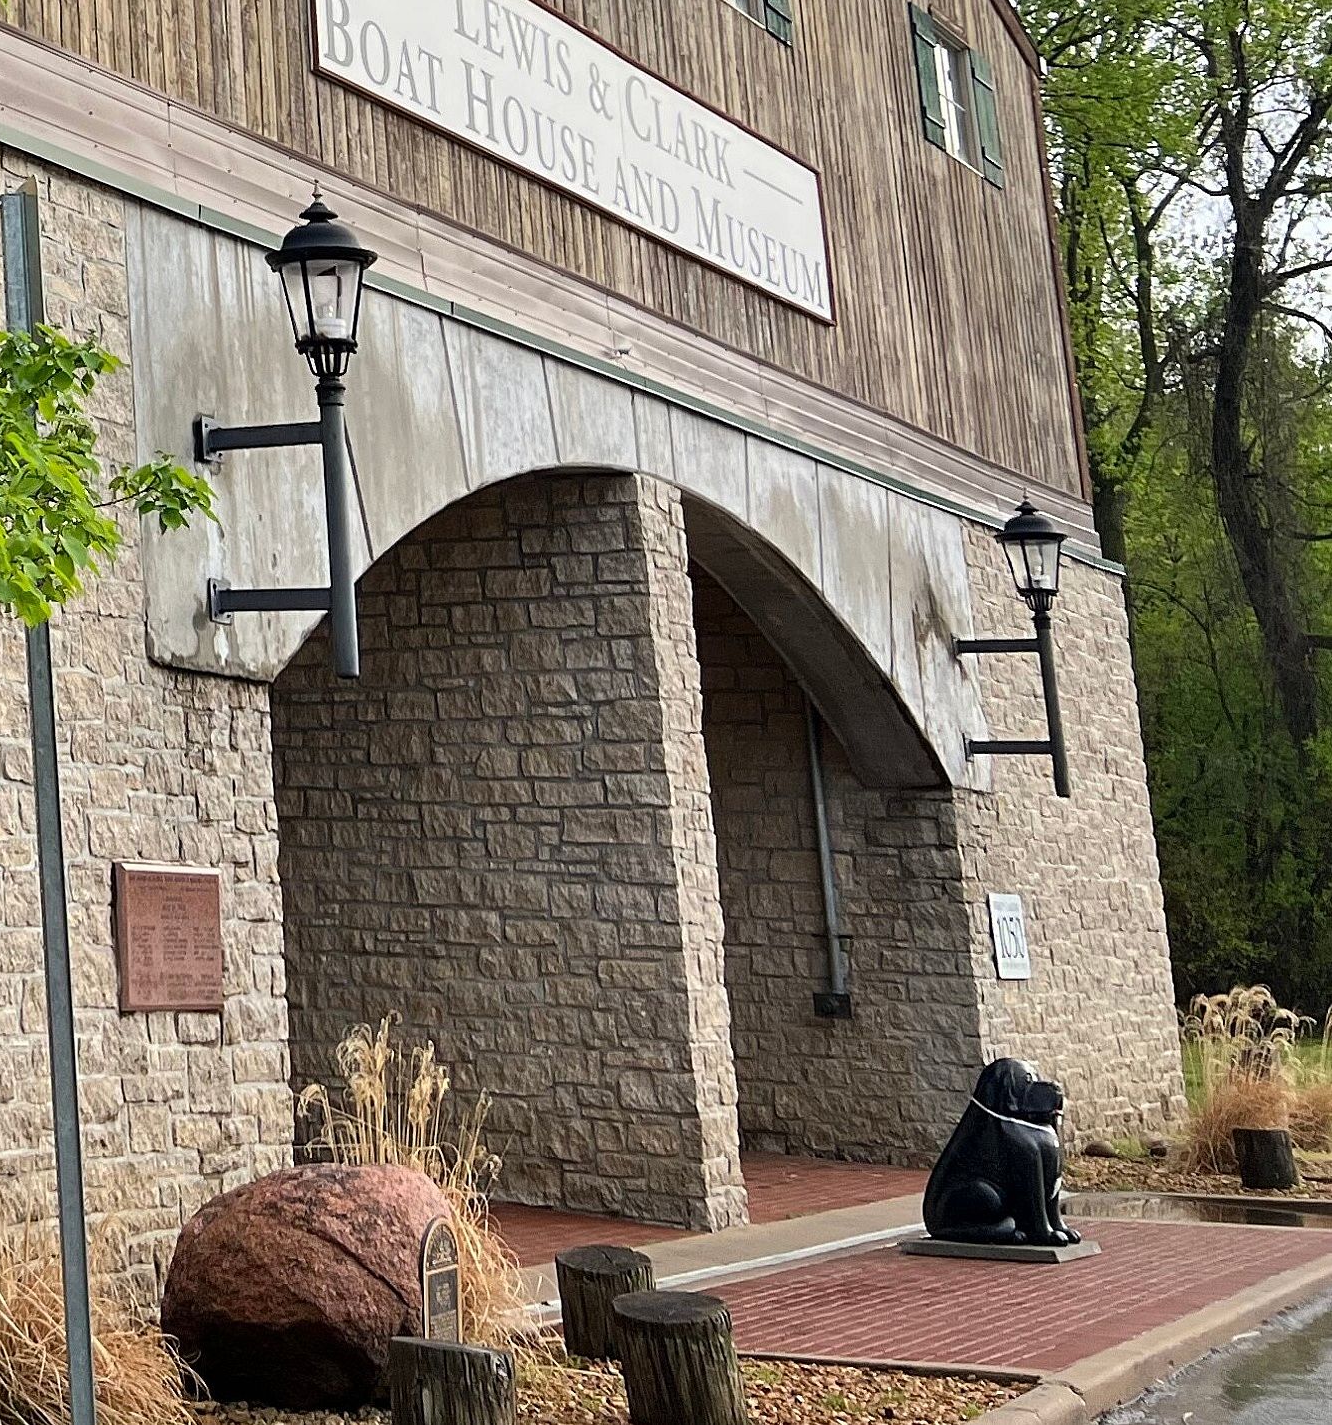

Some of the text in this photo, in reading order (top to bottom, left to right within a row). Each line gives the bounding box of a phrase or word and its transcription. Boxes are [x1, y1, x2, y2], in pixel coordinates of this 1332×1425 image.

[461, 59, 600, 194] HOUSE
[613, 157, 680, 235] AND
[692, 187, 825, 310] MUSEUM
[589, 62, 614, 121] &
[625, 75, 735, 189] CLARK
